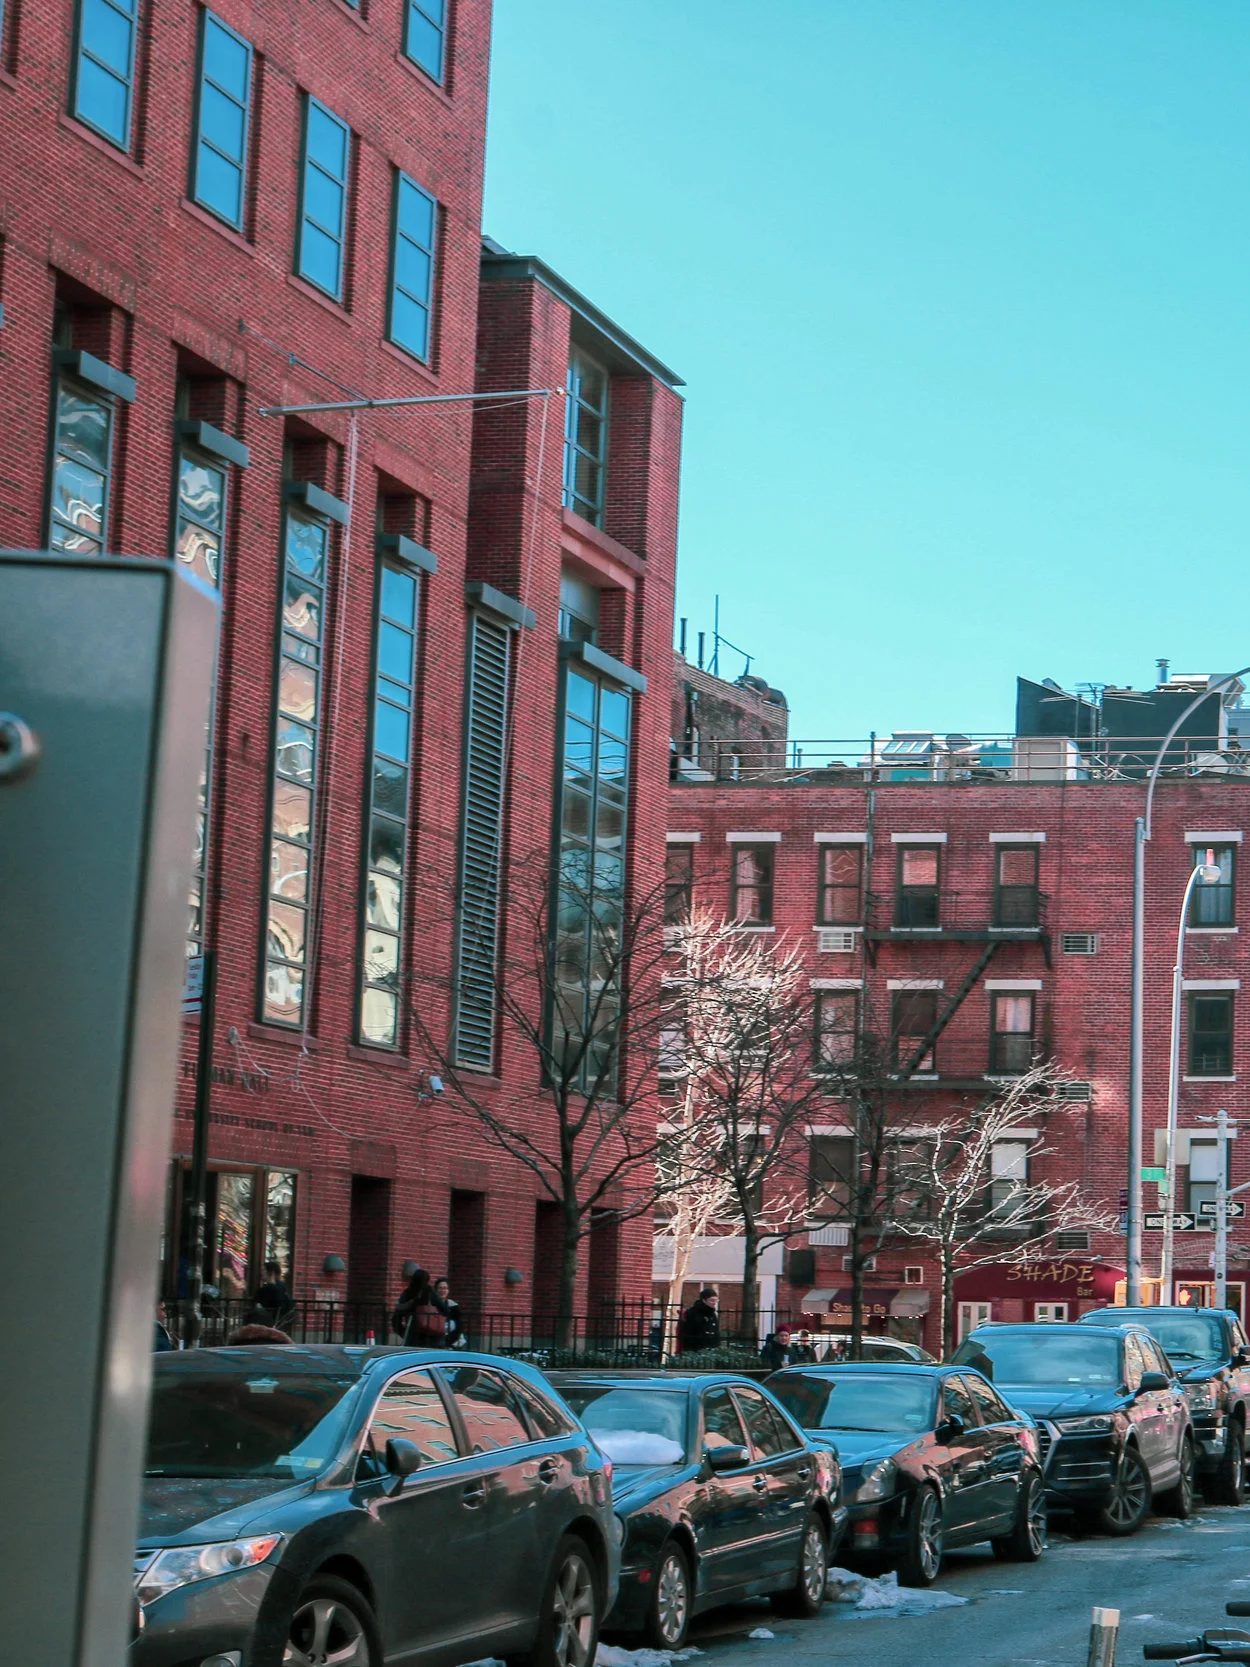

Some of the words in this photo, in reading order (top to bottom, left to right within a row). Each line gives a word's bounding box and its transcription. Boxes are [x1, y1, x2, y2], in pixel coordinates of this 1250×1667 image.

[1006, 1264, 1095, 1283] SHADE
[1076, 1286, 1094, 1297] Bar
[832, 1302, 853, 1313] Sha
[873, 1303, 887, 1314] Go
